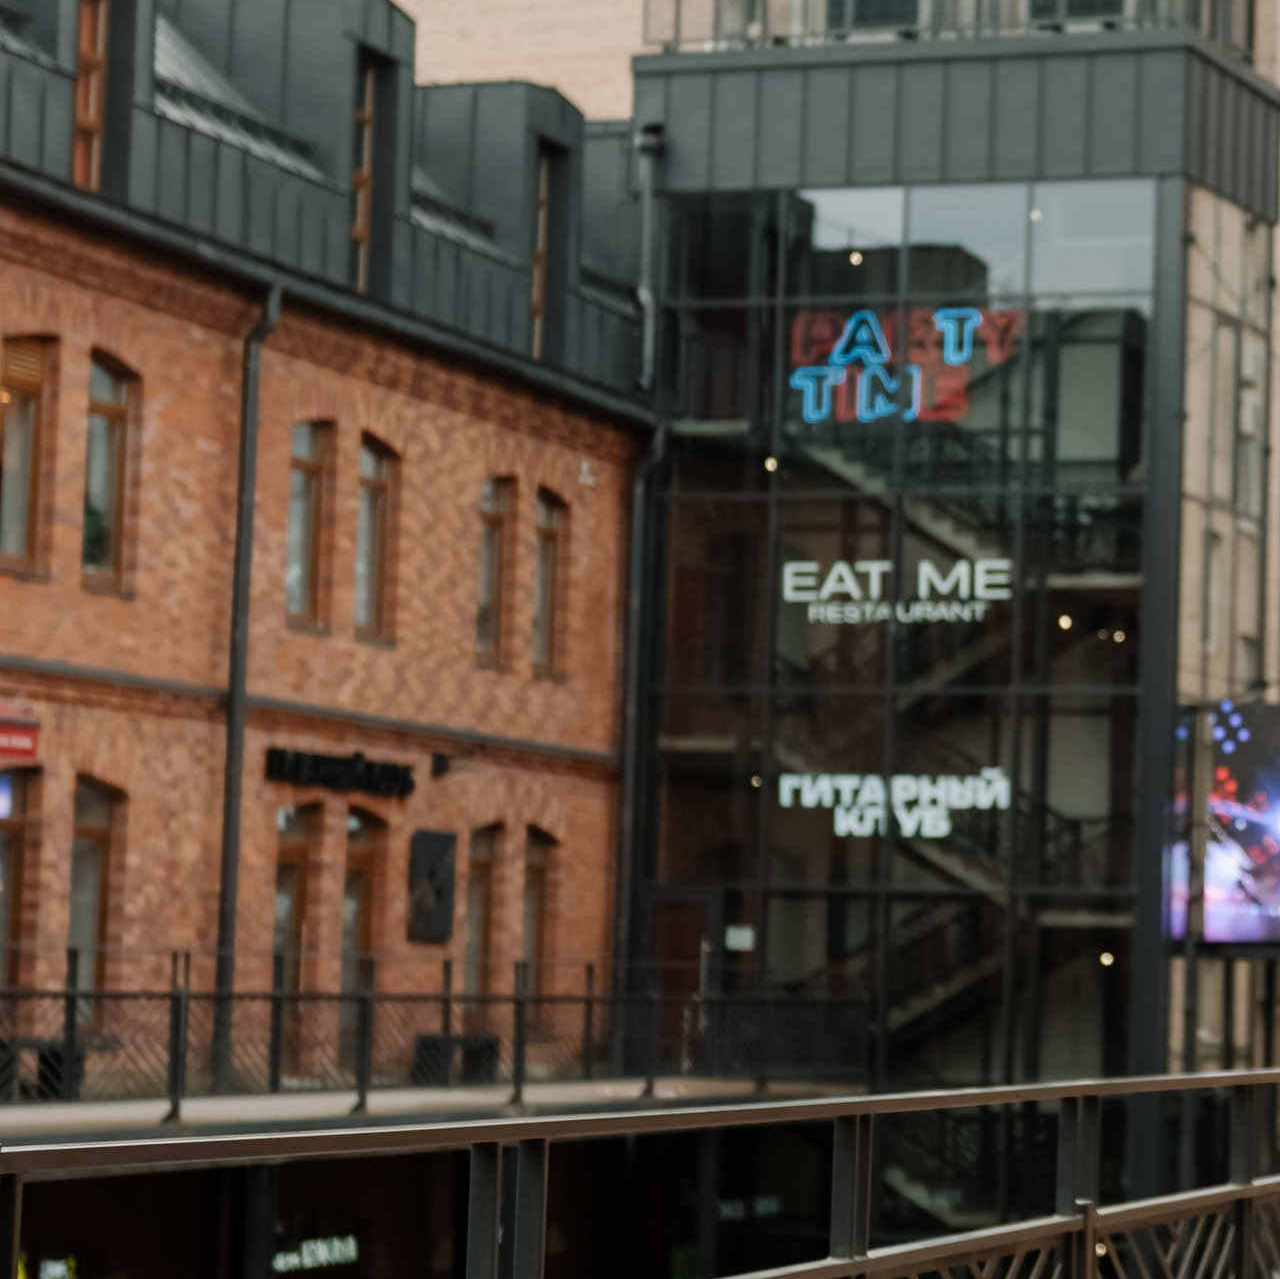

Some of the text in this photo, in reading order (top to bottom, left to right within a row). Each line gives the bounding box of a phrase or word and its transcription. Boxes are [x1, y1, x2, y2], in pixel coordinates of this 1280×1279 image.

[782, 558, 1013, 602] EAT ME
[807, 601, 988, 624] RESTAURANT
[778, 767, 1012, 810] ГИТАРНЫЙ
